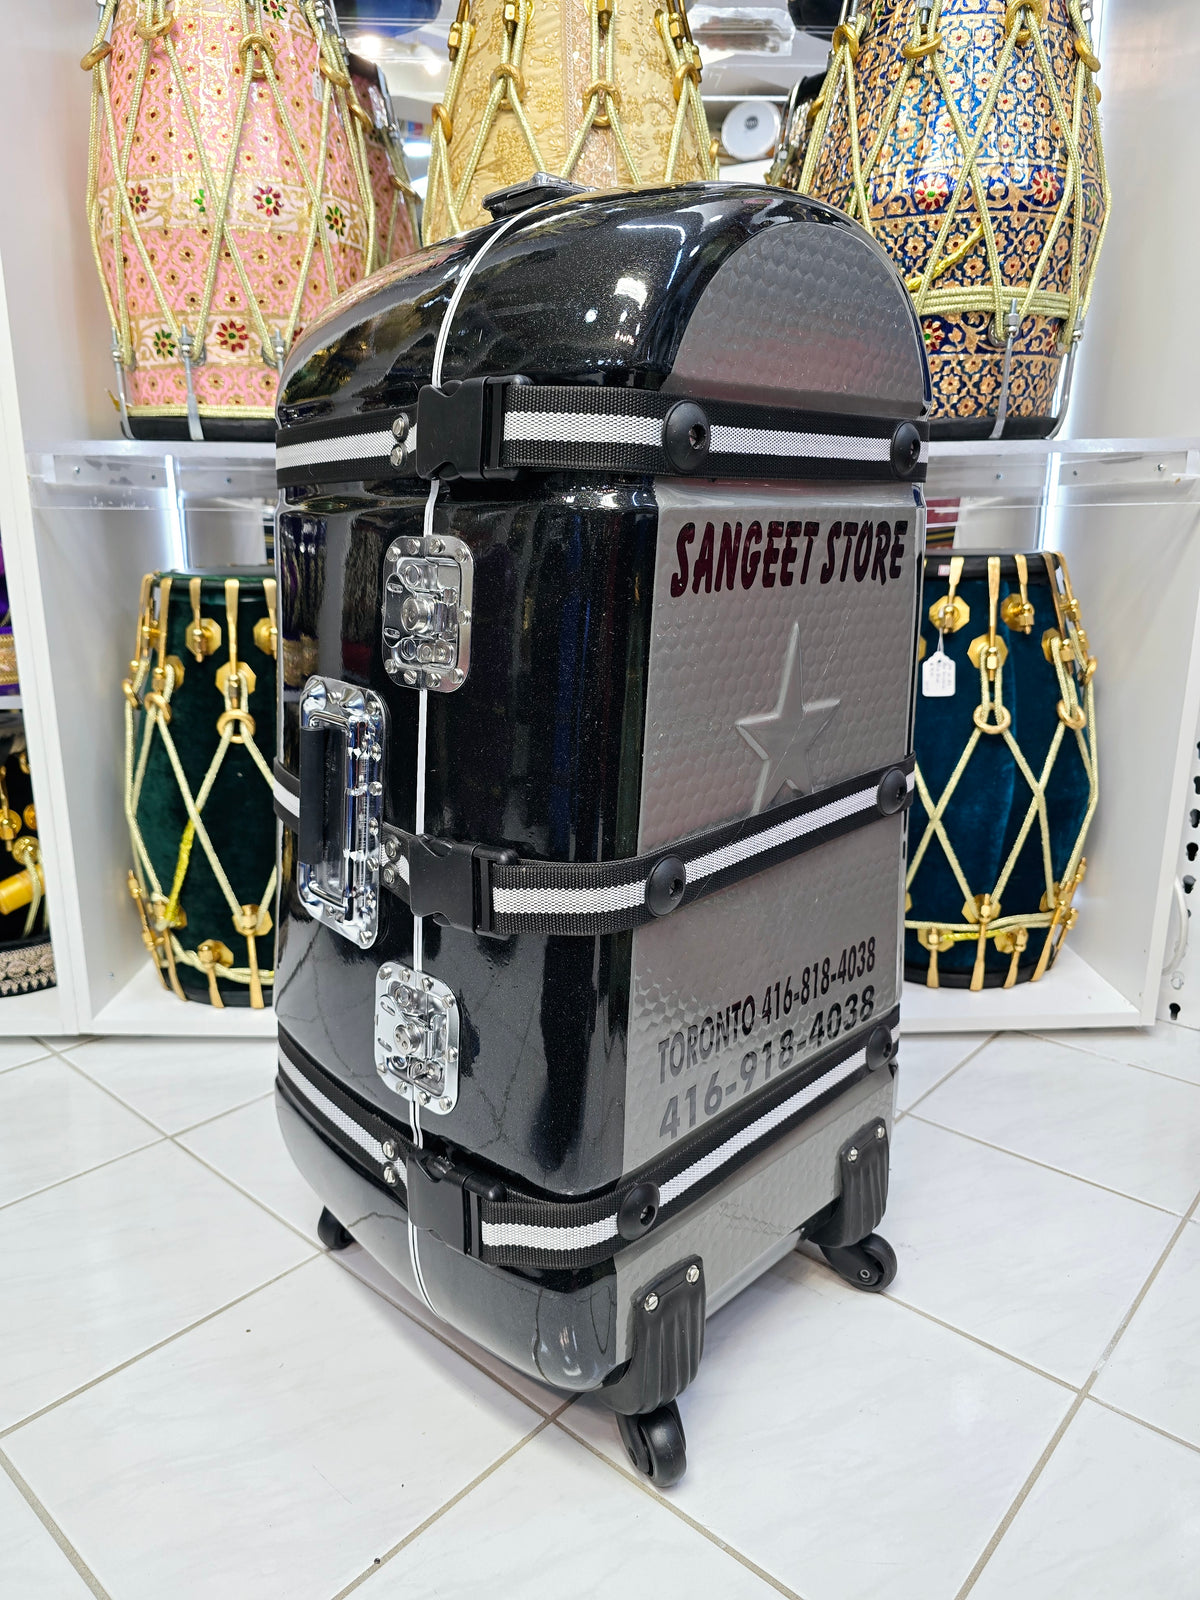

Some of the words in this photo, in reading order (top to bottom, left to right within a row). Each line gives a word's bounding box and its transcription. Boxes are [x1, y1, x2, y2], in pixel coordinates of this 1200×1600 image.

[670, 521, 820, 597] SANGEET
[820, 520, 908, 585] STORE
[658, 995, 756, 1084] TORONTO
[761, 936, 876, 1024] 416-818-4038
[659, 984, 875, 1140] 416-918-4038
